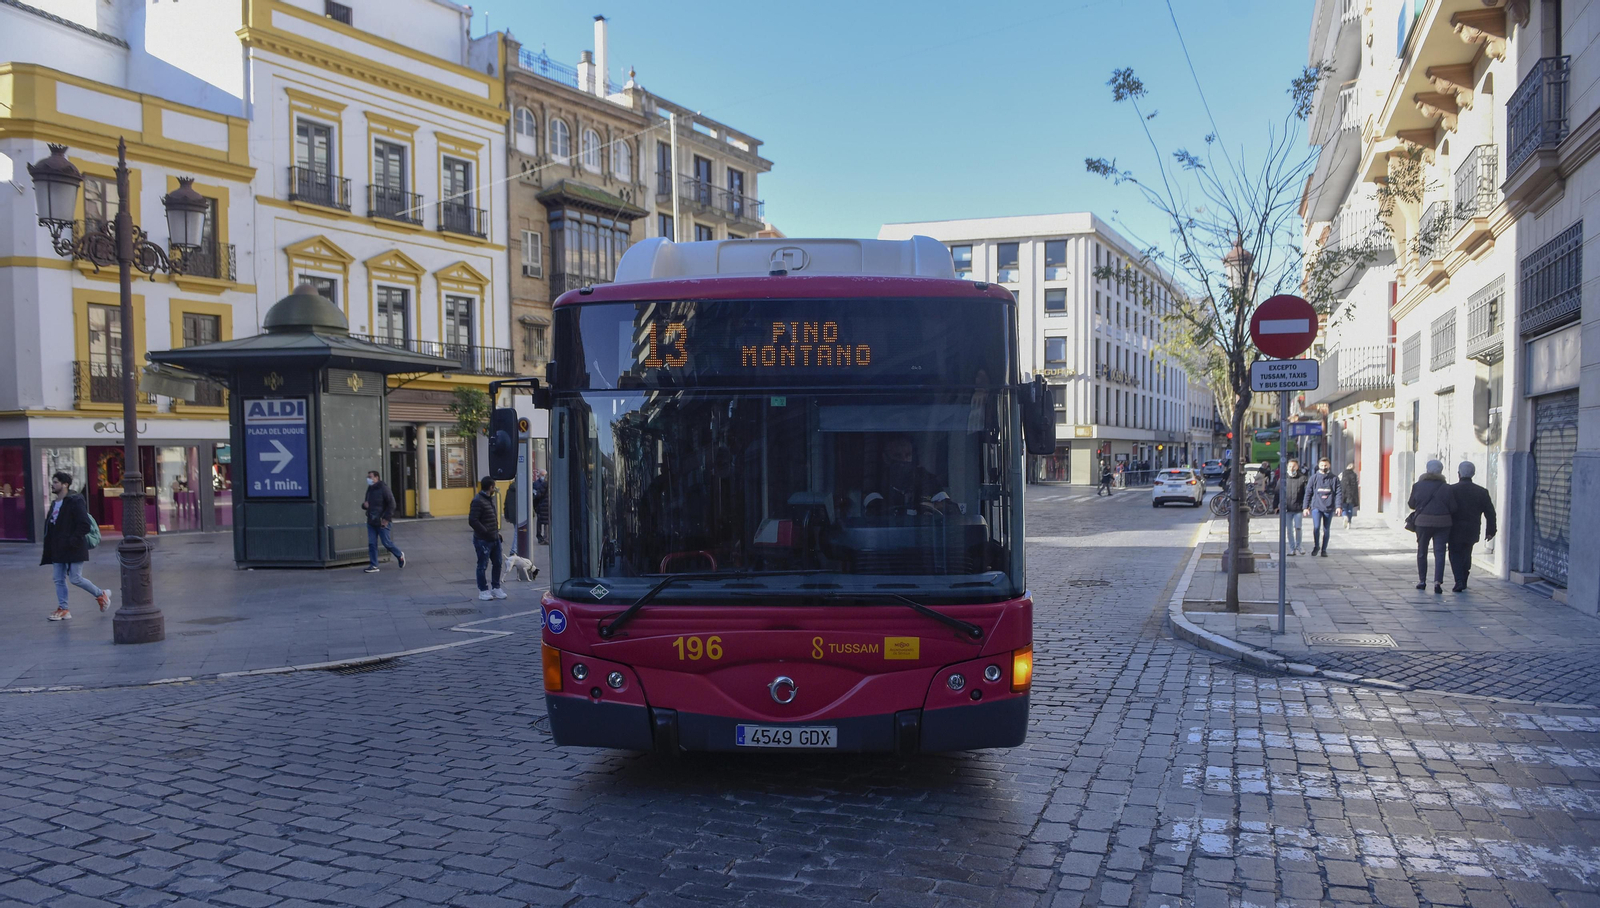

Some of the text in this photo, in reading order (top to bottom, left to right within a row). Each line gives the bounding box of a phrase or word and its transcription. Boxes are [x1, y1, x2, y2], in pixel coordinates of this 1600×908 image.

[772, 321, 838, 343] PINO
[644, 323, 688, 367] 13
[742, 344, 871, 367] MONTANO
[247, 401, 304, 417] ALDI
[282, 427, 305, 435] DUQUE
[254, 478, 302, 490] a 1 min.
[672, 635, 723, 660] 196
[828, 643, 879, 654] TUSSAM
[751, 729, 793, 745] 4549
[799, 730, 831, 746] GDX
